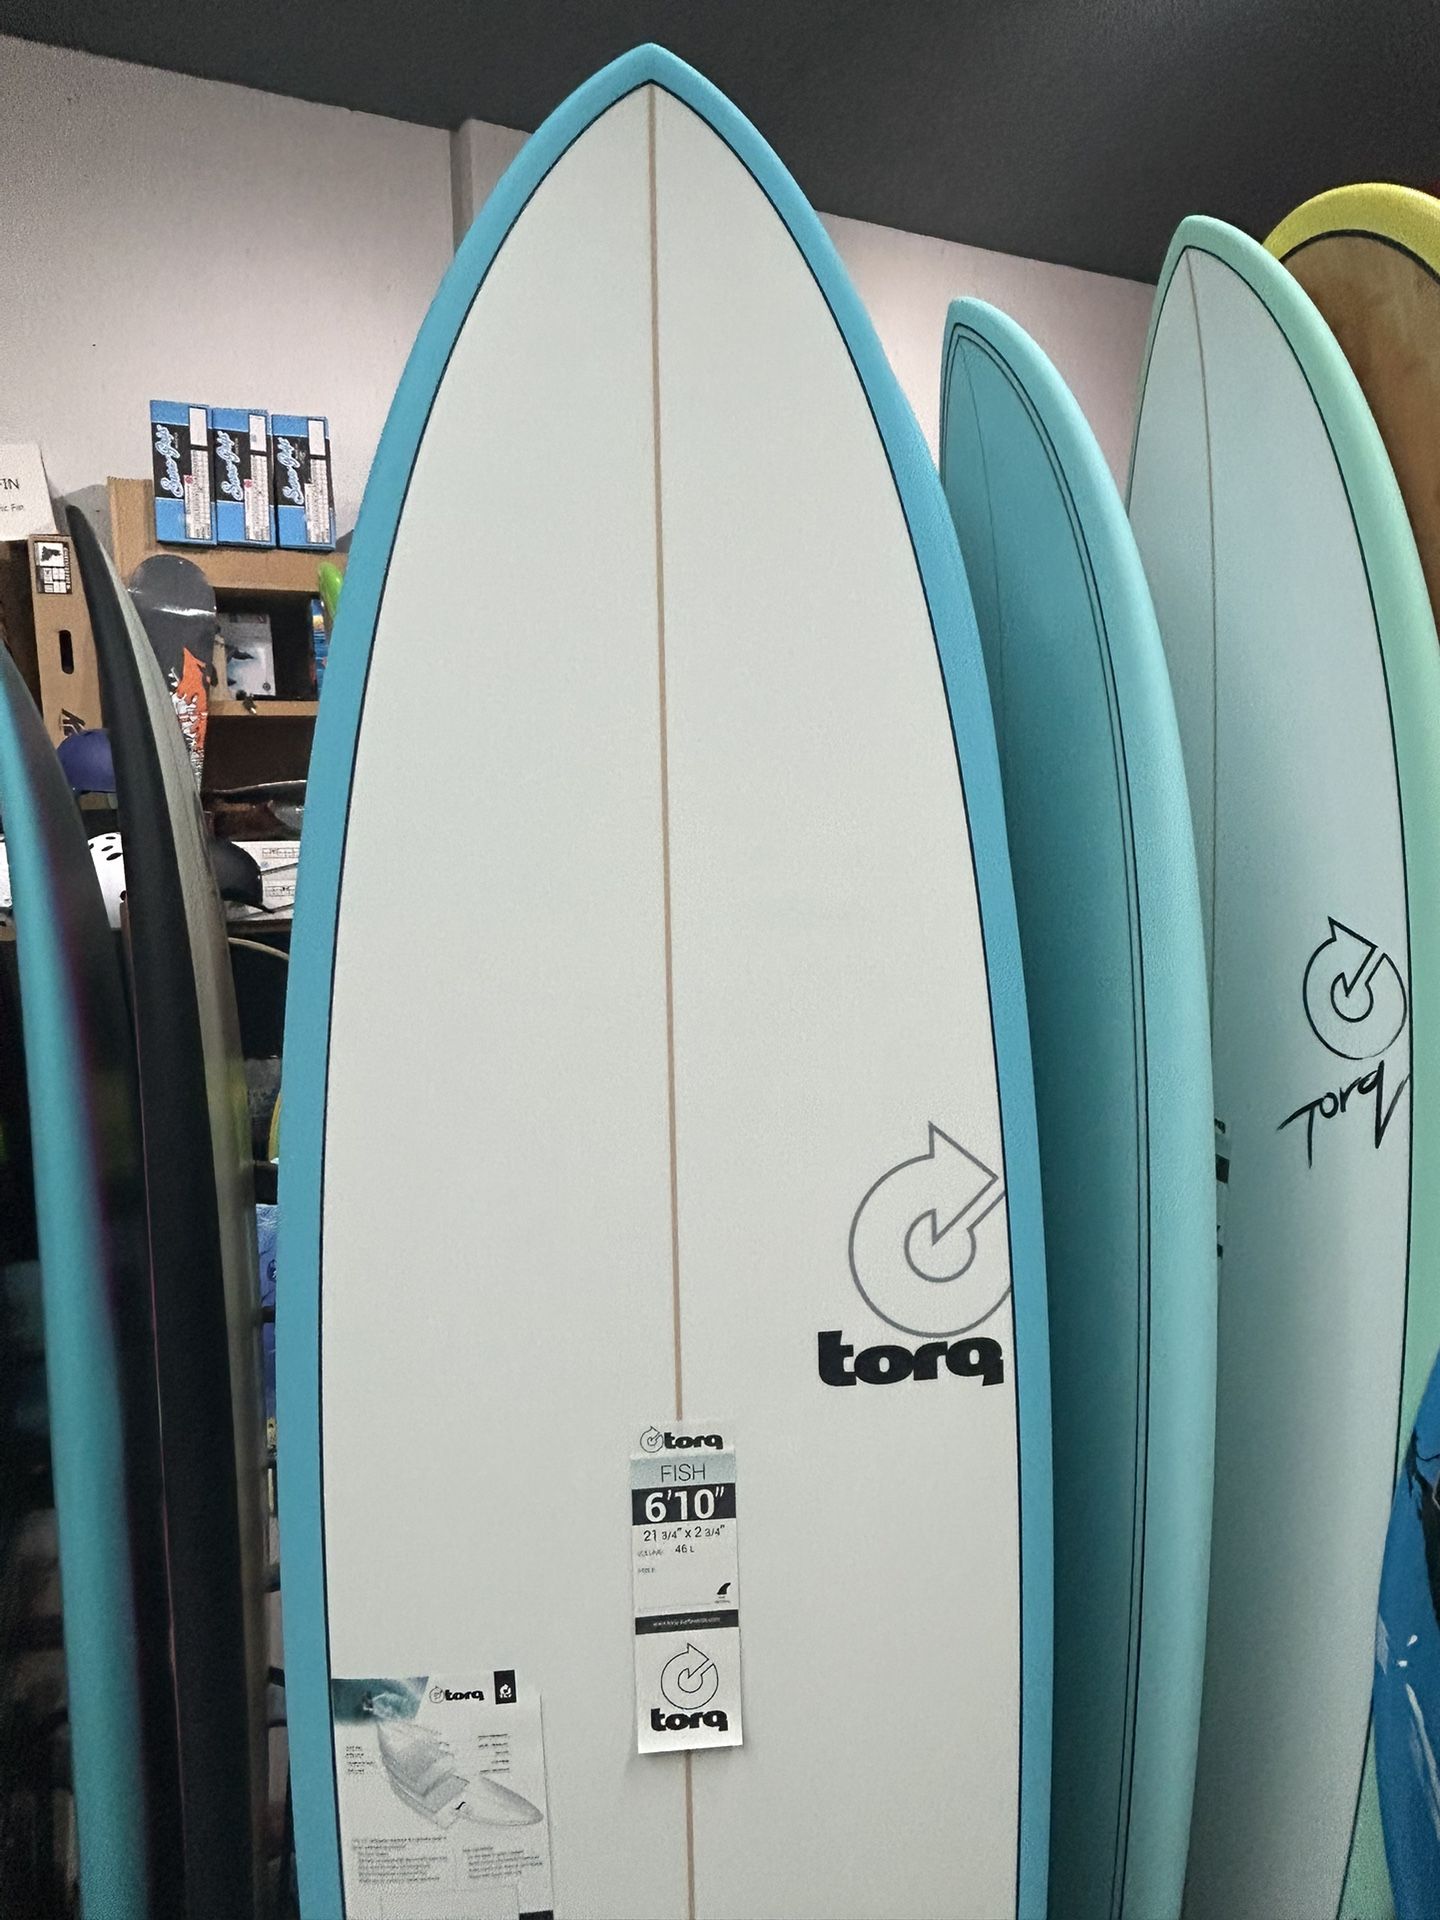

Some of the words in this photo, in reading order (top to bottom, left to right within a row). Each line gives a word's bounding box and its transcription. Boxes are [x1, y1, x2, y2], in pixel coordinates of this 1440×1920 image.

[818, 1330, 1004, 1387] torq
[664, 1431, 724, 1450] torq
[660, 1463, 706, 1483] FISH
[643, 1529, 657, 1542] 21
[694, 1526, 702, 1538] 2
[675, 1544, 688, 1554] 46
[444, 1688, 485, 1702] torq
[650, 1707, 729, 1732] torq
